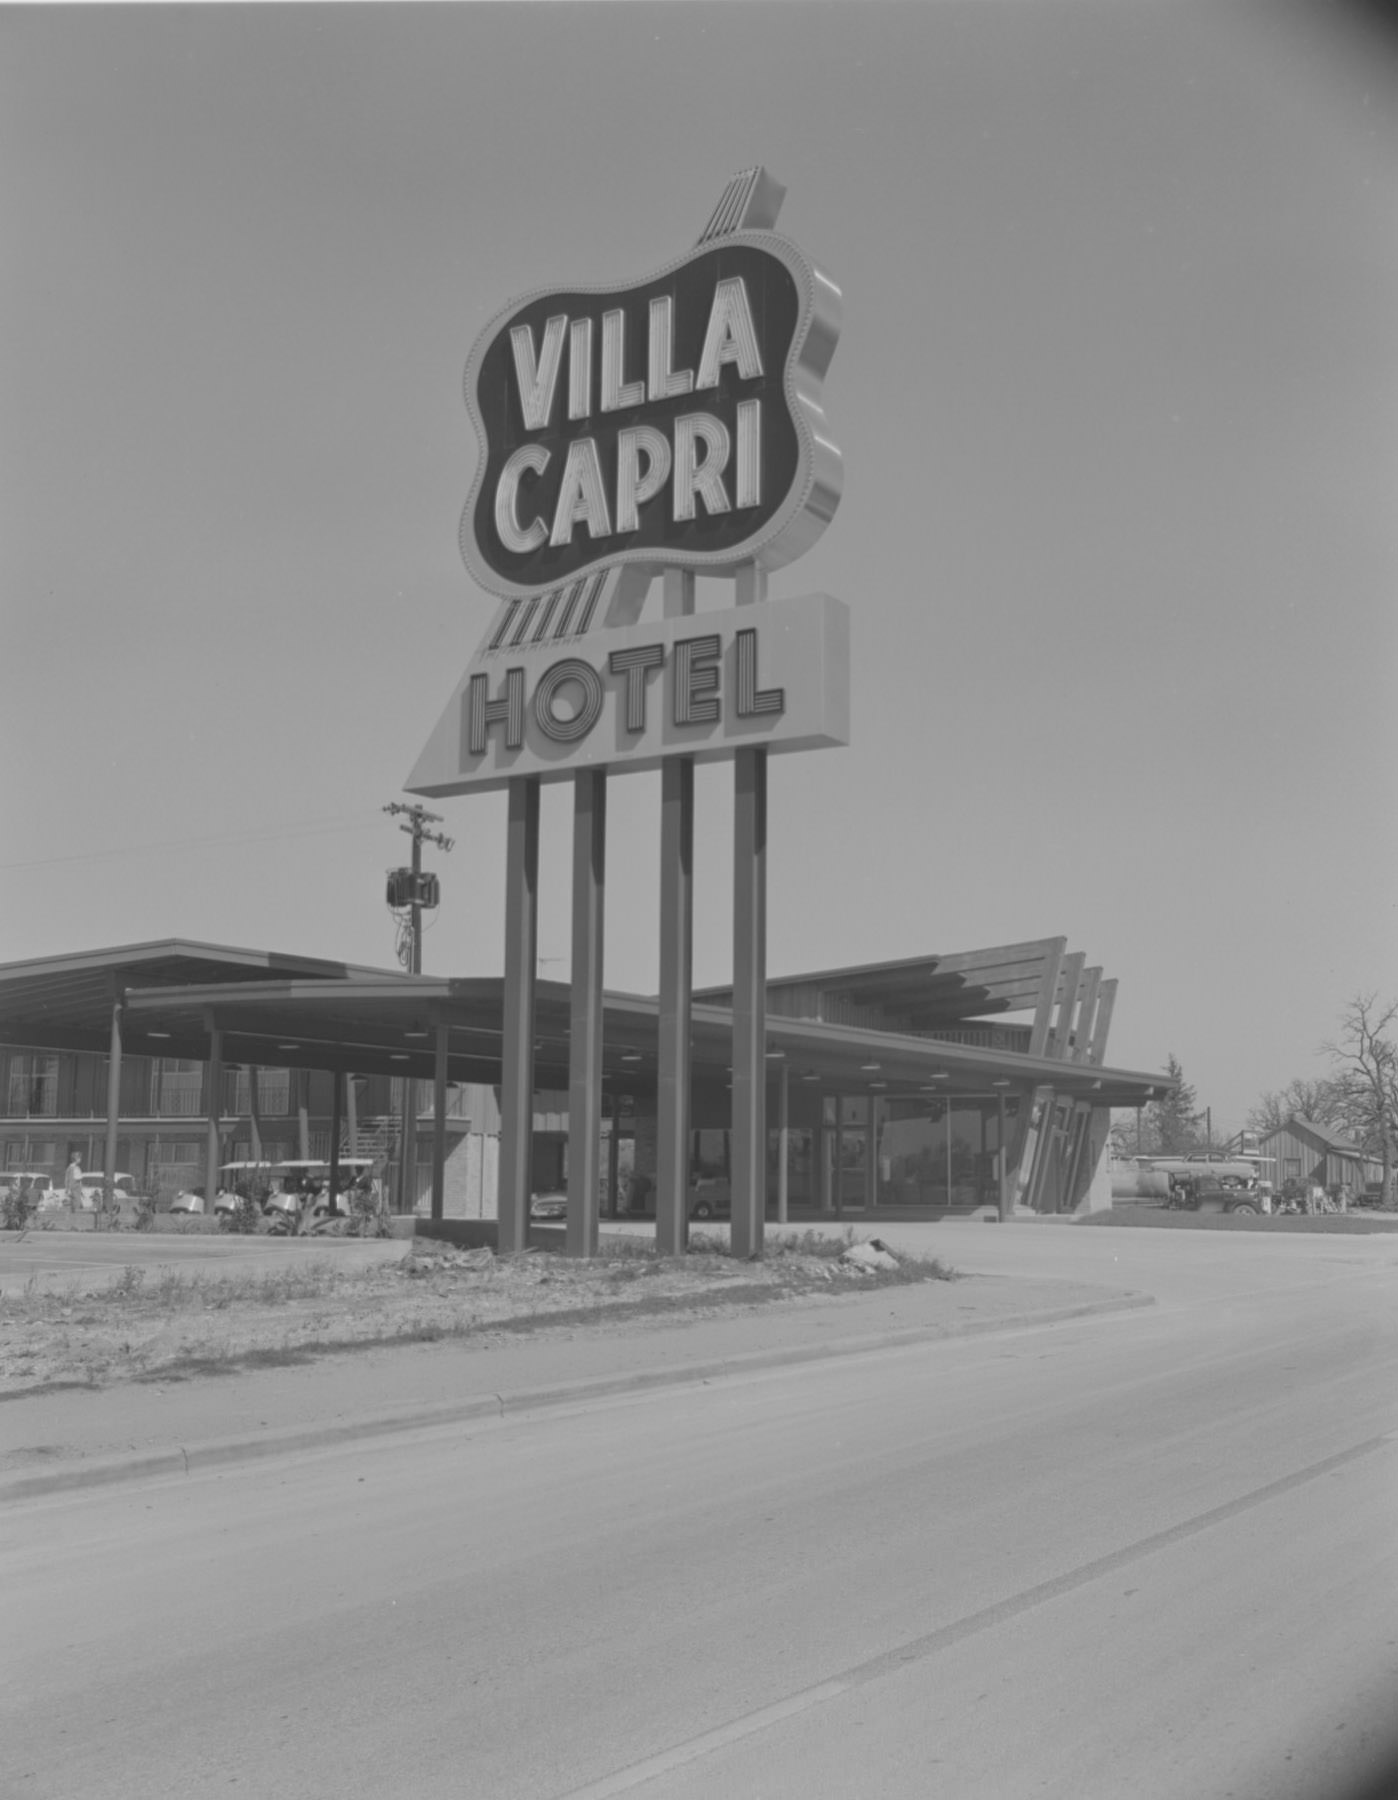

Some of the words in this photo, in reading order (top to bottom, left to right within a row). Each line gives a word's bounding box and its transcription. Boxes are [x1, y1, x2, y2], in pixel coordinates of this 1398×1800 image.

[510, 276, 764, 431] VILLA
[495, 399, 761, 554] CAPRI
[469, 628, 785, 755] HOTEL
